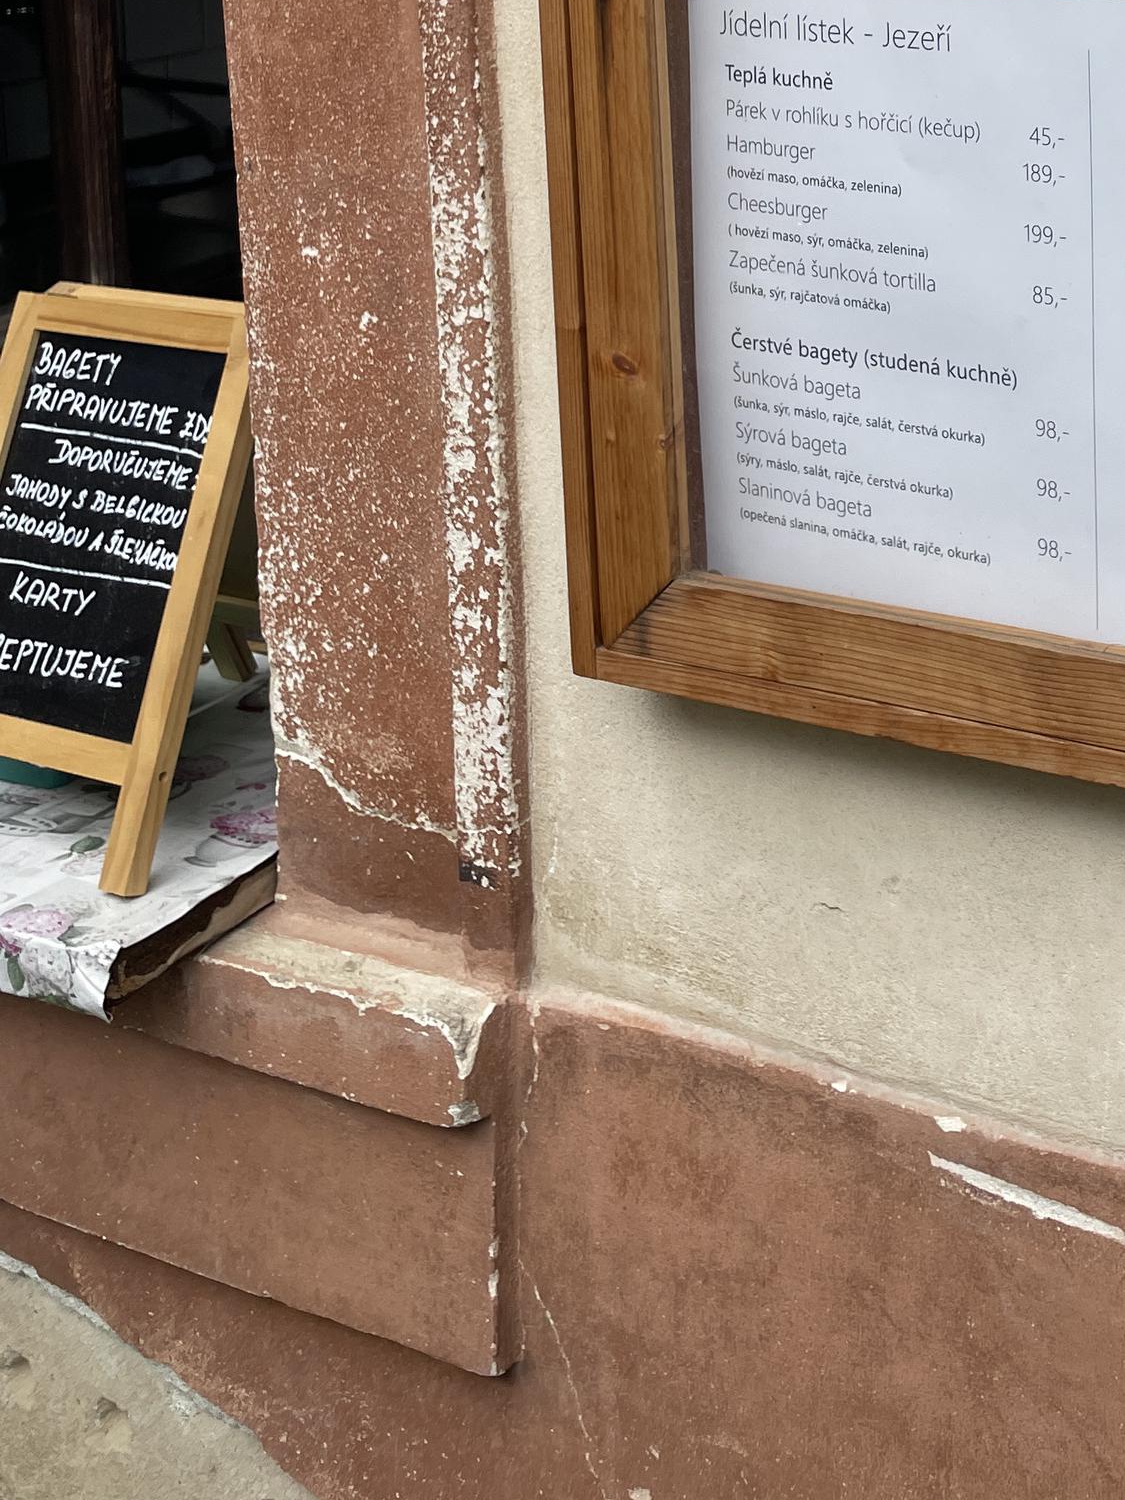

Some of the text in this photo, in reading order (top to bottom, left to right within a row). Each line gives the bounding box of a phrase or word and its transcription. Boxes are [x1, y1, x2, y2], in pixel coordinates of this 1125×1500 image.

[719, 10, 951, 52] Jídelní lístek Jezeří
[725, 64, 833, 90] Teplá kuchně
[726, 100, 1065, 149] Párek rohlíku hořčicí (kečup) 45,-
[727, 135, 1065, 185] Hamburger 189,-
[727, 166, 902, 197] (hovězí maso, omáčka, zelenina)
[728, 192, 1066, 247] Cheesburger 199,-
[728, 249, 1067, 308] Zapečená šunková tortilla 85,-
[35, 342, 122, 386] BAGETY
[731, 327, 1017, 391] Čerstvé bagety (studená kuchně)
[733, 361, 1069, 443] Šunková bageta 98,-
[734, 395, 985, 446] (šunka, sýr, máslo, rajče, salát, čerstvá okurka)
[736, 422, 1070, 502] Sýrová bageta 98,-
[6, 474, 72, 509] JAHODY
[738, 477, 872, 518] Slaninová bageta
[9, 571, 96, 616] KARTY
